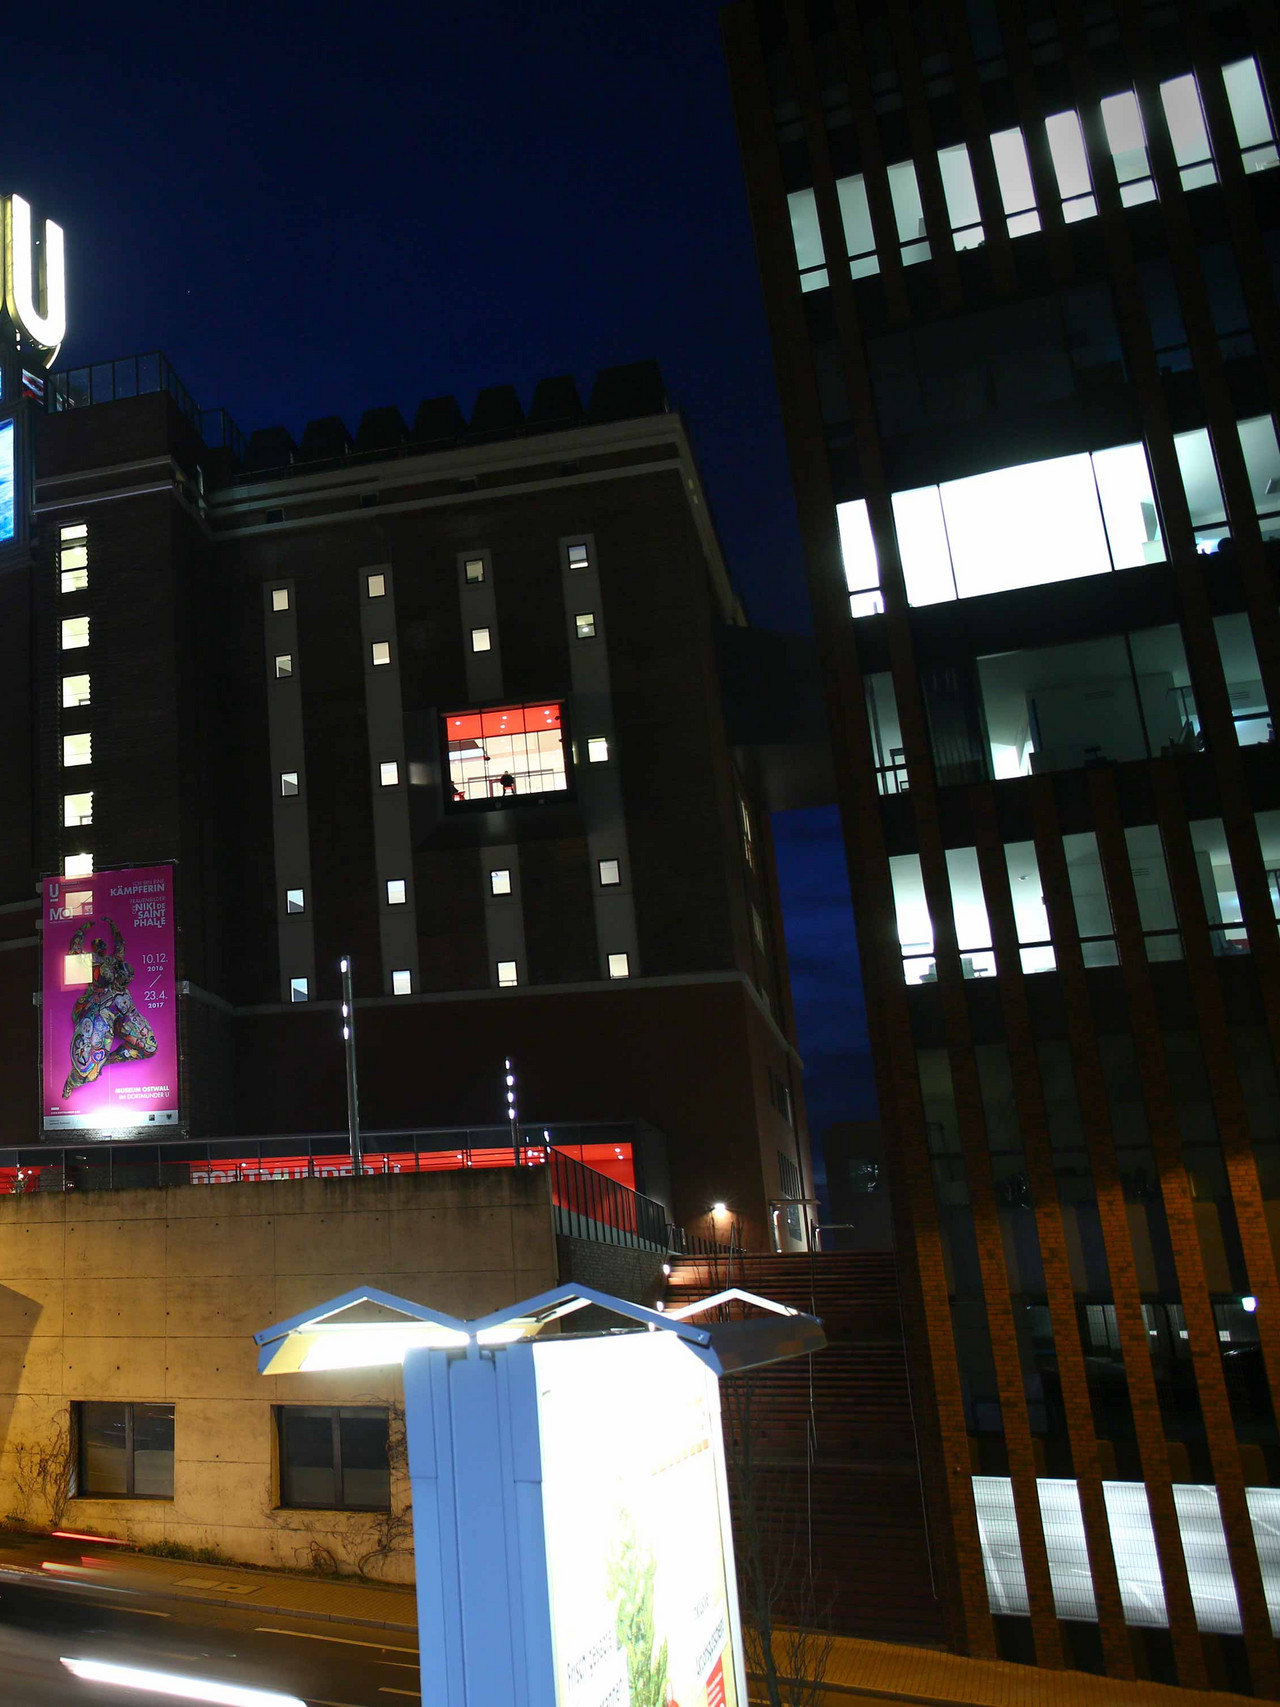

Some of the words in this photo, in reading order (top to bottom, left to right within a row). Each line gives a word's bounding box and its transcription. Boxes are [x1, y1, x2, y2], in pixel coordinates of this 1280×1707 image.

[110, 884, 165, 896] KÄMPFERIN
[135, 902, 156, 911] NIKI
[137, 909, 166, 919] SAINT
[142, 953, 168, 964] 10.12.
[144, 990, 168, 1001] 23.4.
[127, 1092, 164, 1100] DORTMUNDER
